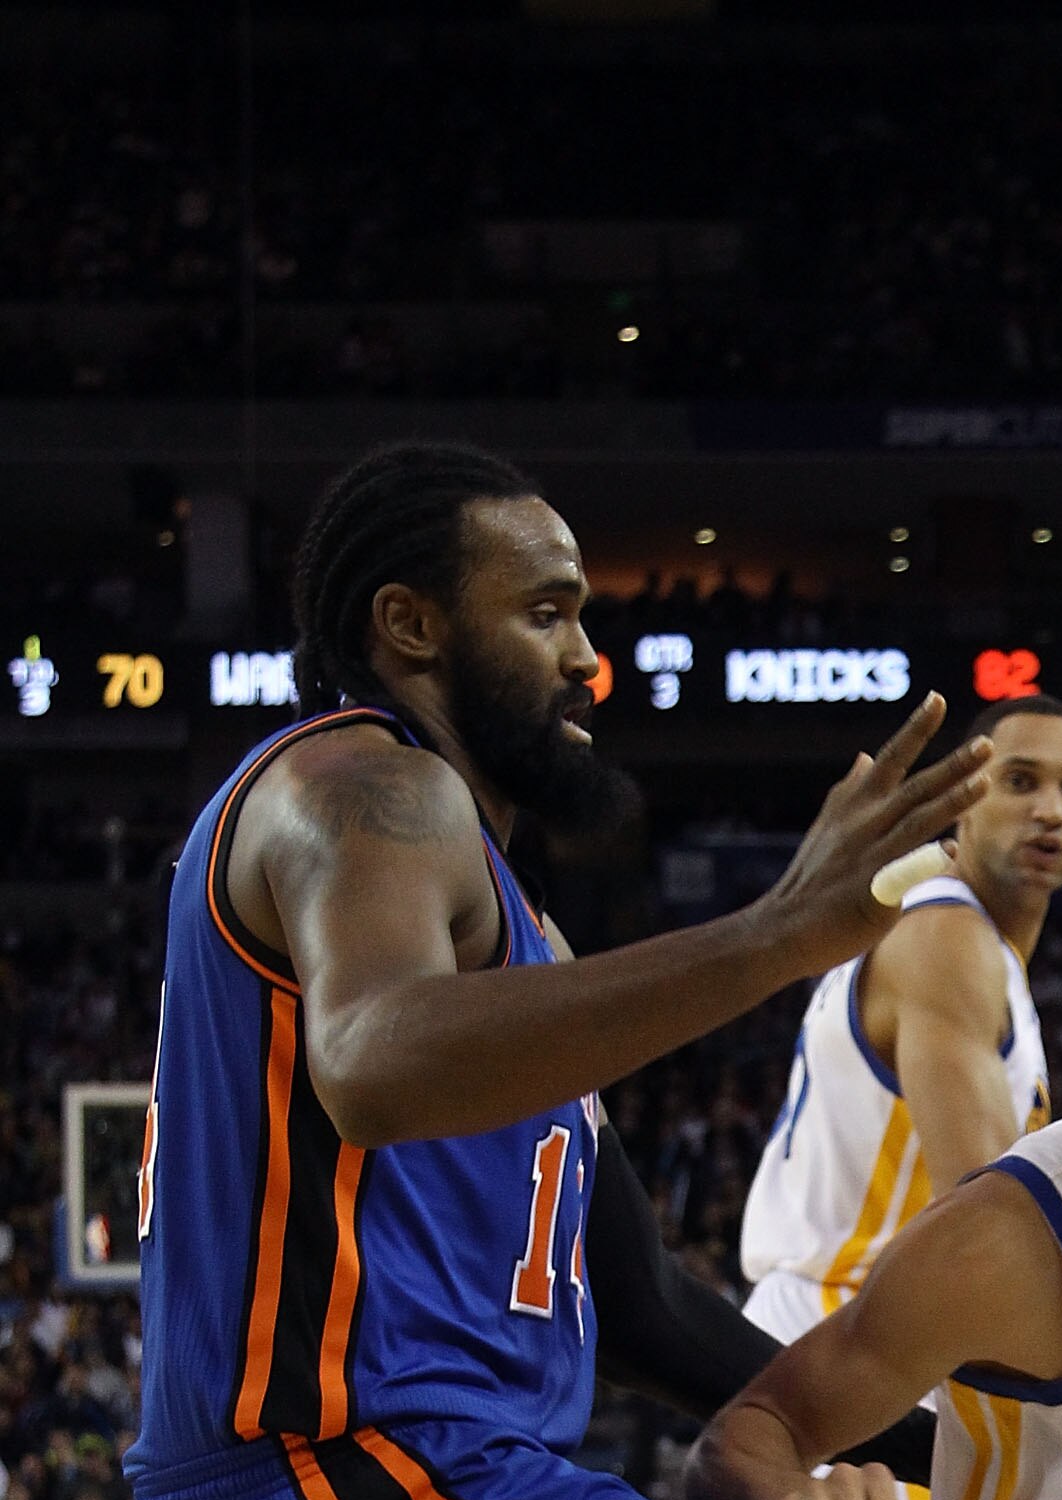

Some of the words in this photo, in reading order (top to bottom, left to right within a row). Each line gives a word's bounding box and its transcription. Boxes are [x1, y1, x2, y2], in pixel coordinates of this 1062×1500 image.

[97, 652, 164, 709] 70
[725, 648, 911, 702] KNICKS
[973, 649, 1041, 701] 82
